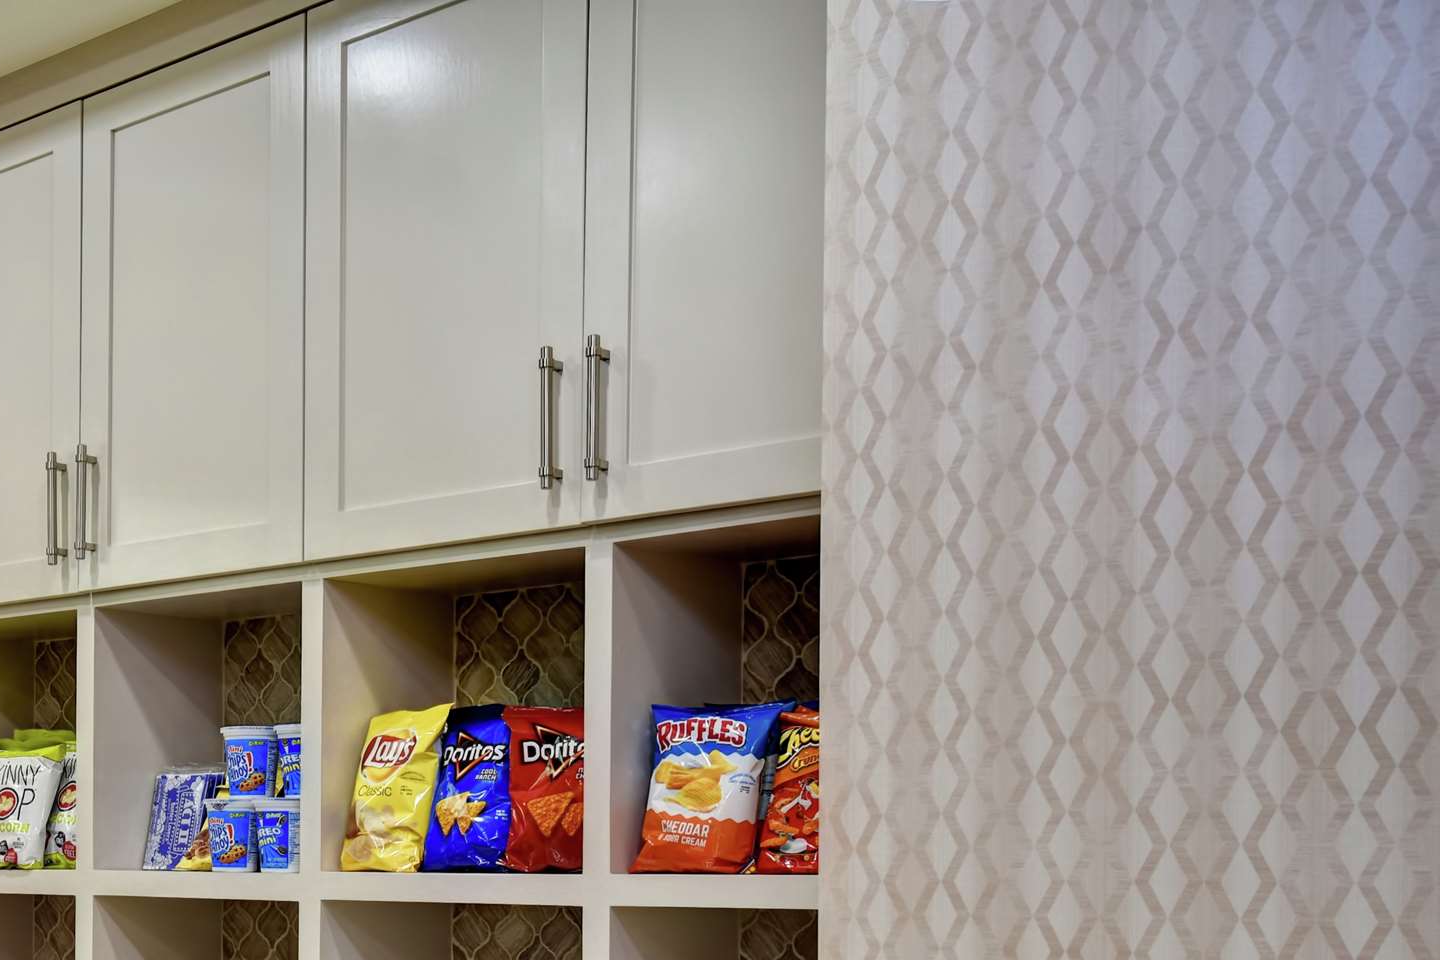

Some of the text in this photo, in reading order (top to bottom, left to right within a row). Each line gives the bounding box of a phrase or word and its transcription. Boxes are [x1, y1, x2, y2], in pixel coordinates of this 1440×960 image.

[657, 717, 748, 754] RUFFLES
[444, 743, 506, 767] Doritos
[523, 737, 584, 763] Dorito
[357, 784, 393, 798] Classic
[661, 819, 709, 838] CHEDDAR
[680, 836, 707, 848] CREAM
